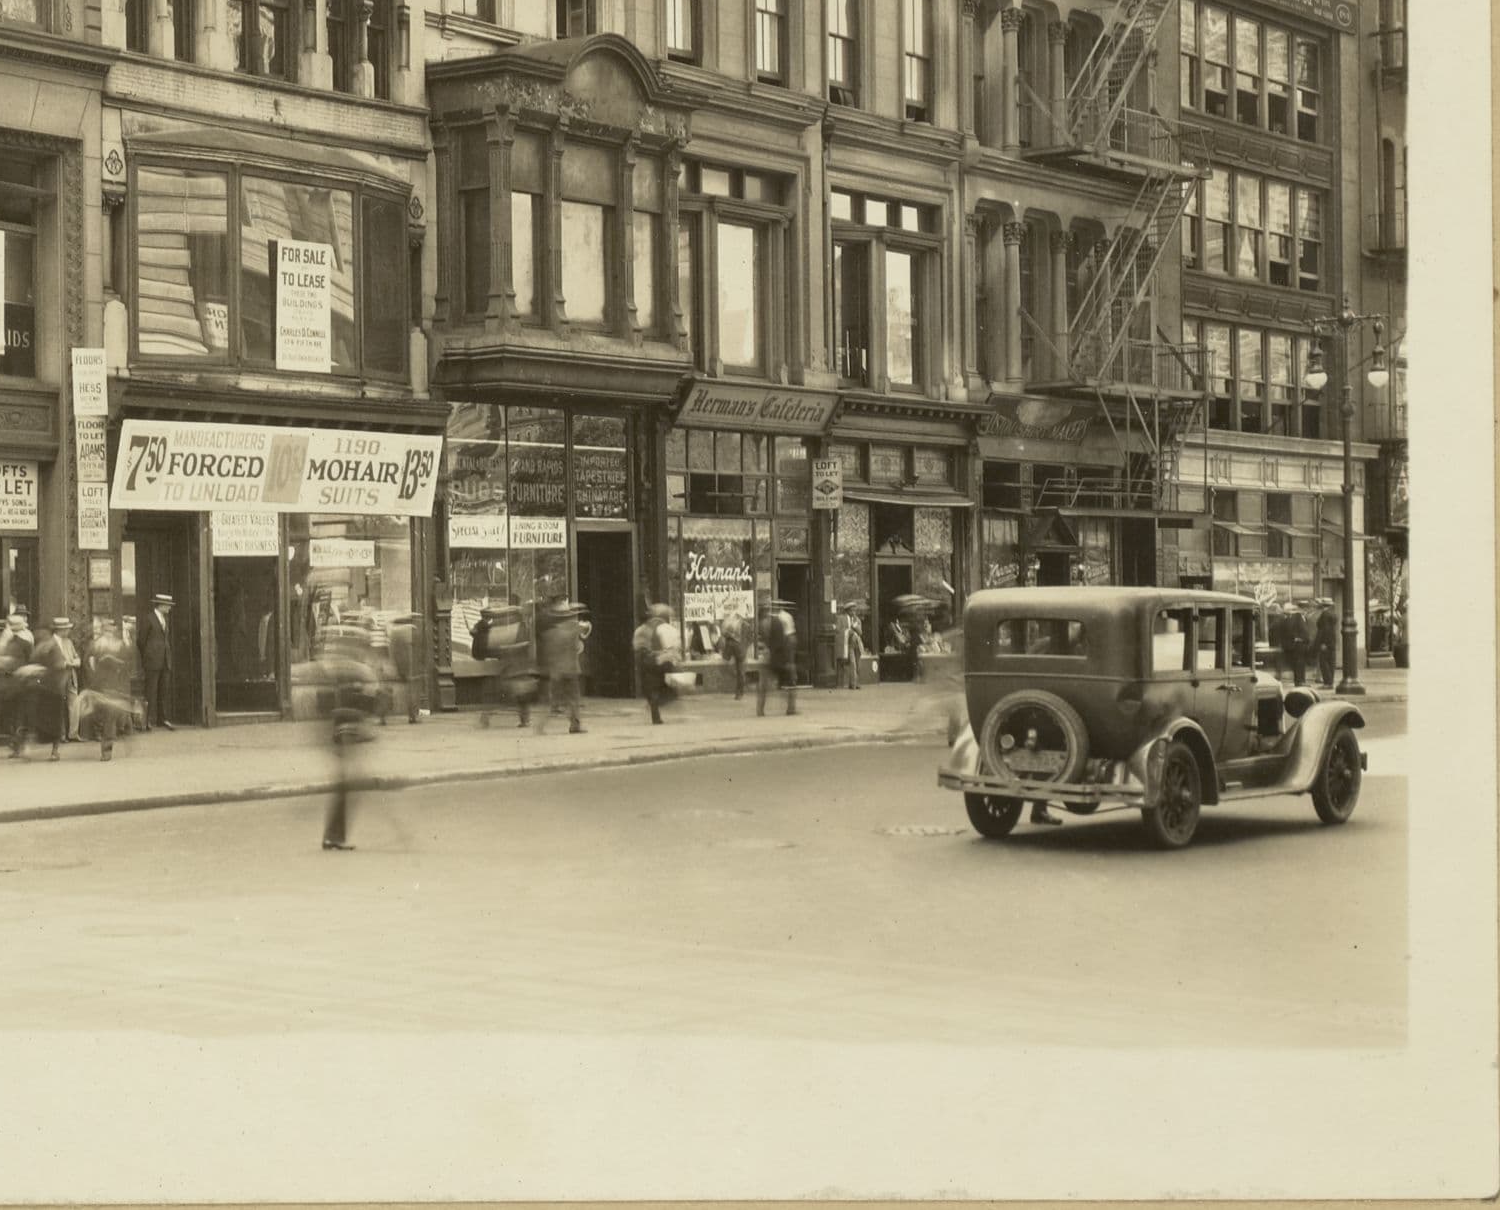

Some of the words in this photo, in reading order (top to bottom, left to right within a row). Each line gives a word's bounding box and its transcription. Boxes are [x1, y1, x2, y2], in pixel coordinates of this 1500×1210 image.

[281, 246, 302, 266] FOR
[302, 248, 326, 266] SALE
[282, 272, 295, 287] TO
[297, 273, 326, 290] LEASE
[282, 298, 324, 310] BUILDINGS
[79, 382, 102, 394] HESS
[689, 388, 757, 419] Herman's
[758, 394, 827, 424] Cafeteria
[77, 420, 105, 430] FLOOR
[79, 432, 90, 440] TO
[90, 432, 104, 440] LET
[173, 429, 267, 452] MANUFACTURERS
[79, 444, 106, 461] ADAMS
[167, 452, 265, 479] FORCED
[306, 458, 400, 485] MOHAIR
[815, 461, 838, 471] LOFT
[4, 479, 34, 496] LET
[81, 486, 104, 498] LOFT
[163, 482, 185, 501] TO
[189, 482, 260, 503] UNLOAD
[317, 485, 381, 507] SUITS
[510, 483, 565, 504] FURNITURE
[250, 513, 275, 526] VALUES
[513, 532, 564, 545] FURNITURE
[685, 551, 753, 583] Herman's
